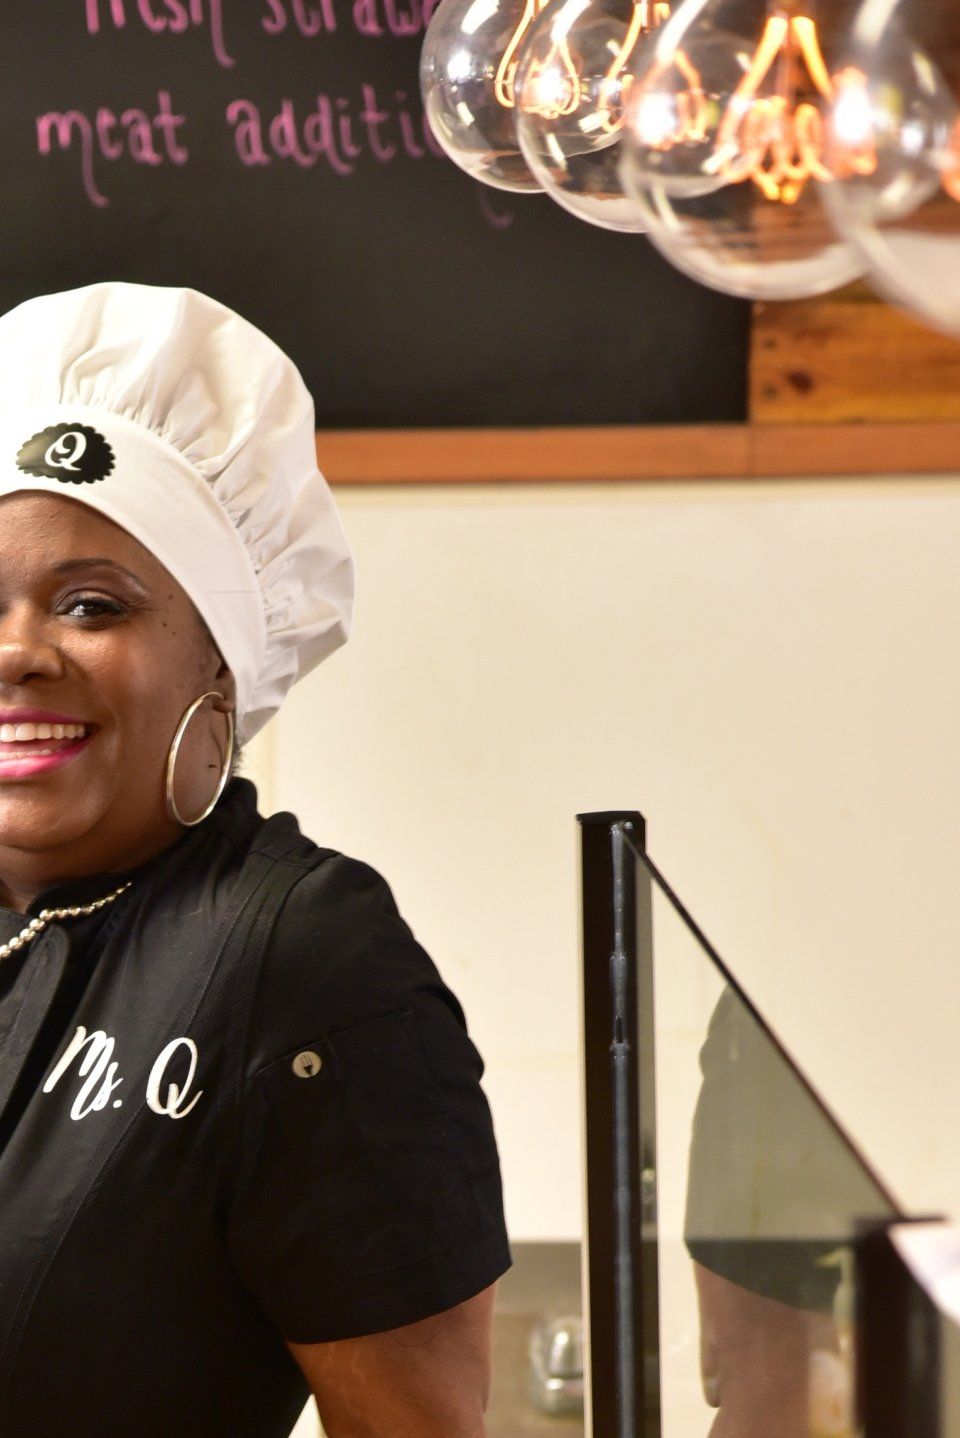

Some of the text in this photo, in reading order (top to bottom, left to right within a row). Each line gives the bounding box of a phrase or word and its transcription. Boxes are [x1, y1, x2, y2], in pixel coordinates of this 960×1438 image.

[36, 90, 189, 208] meat
[44, 431, 87, 471] Q
[43, 1026, 203, 1121] Ms. Q
